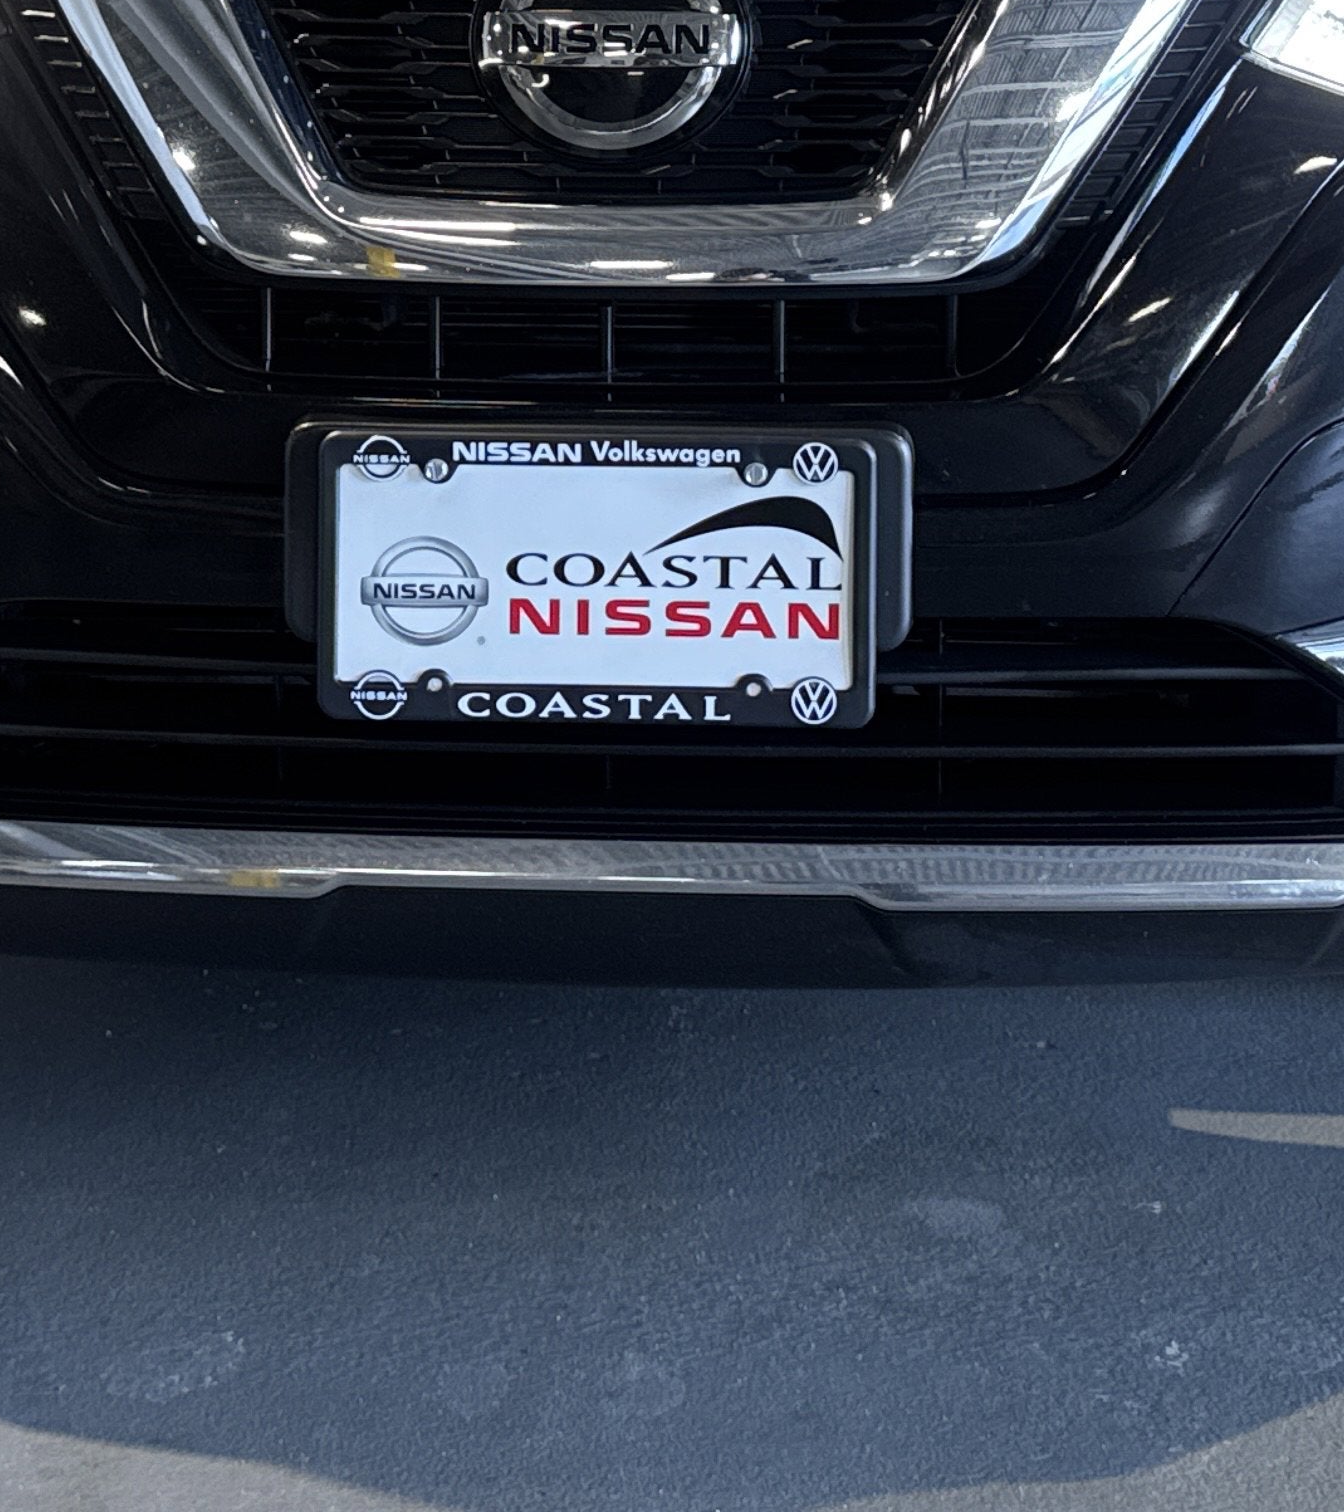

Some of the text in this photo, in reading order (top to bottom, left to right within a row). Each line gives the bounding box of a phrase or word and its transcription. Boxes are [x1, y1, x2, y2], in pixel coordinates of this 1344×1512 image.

[510, 22, 710, 54] NISSAN
[353, 454, 410, 464] NISSAN
[453, 440, 741, 467] NISSAN Volkswagen
[506, 551, 843, 591] COASTAL
[373, 583, 475, 601] NISSAN
[509, 598, 840, 641] NISSAN
[350, 690, 408, 701] NISSAN
[457, 691, 732, 721] COASTAL
